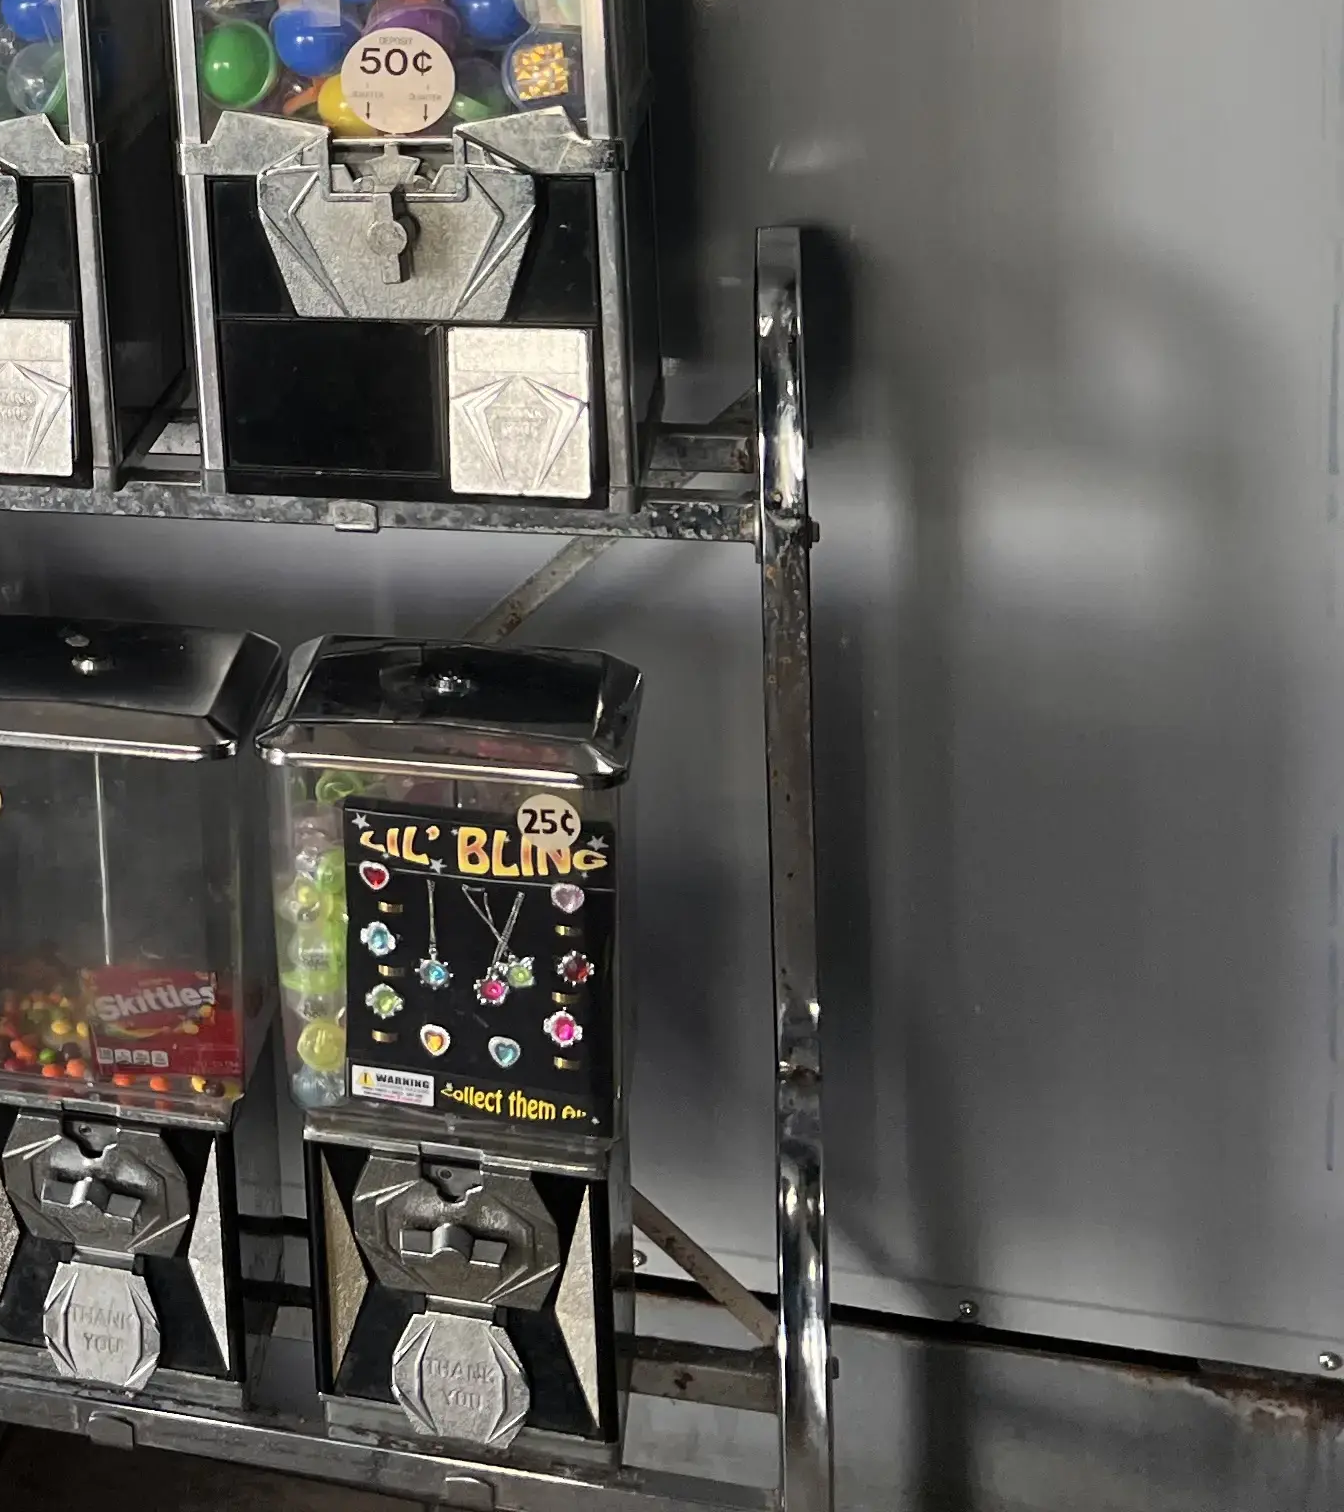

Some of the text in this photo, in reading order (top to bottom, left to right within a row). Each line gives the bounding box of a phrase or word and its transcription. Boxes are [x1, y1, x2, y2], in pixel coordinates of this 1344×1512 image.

[360, 47, 432, 76] 50¢
[521, 808, 575, 836] 25¢
[457, 826, 608, 877] BLING
[94, 984, 216, 1022] Skittles
[376, 1073, 430, 1090] WARNING
[508, 1091, 556, 1121] them
[68, 1304, 136, 1329] THANK
[82, 1329, 124, 1353] YOU
[427, 1357, 497, 1385] THANK
[441, 1388, 482, 1409] YOU
